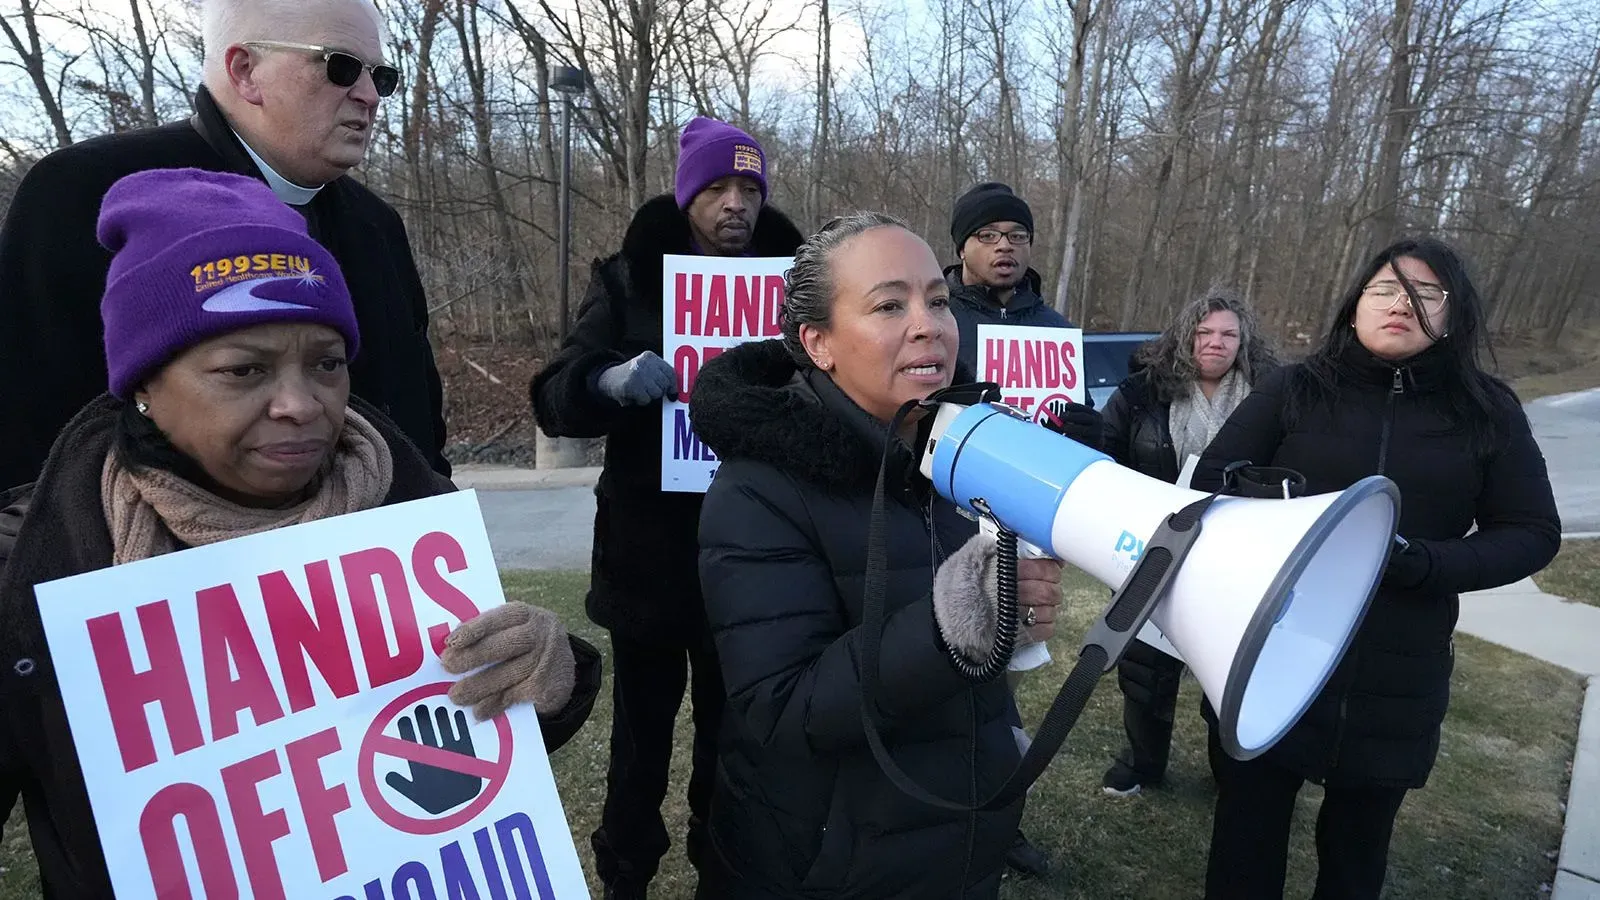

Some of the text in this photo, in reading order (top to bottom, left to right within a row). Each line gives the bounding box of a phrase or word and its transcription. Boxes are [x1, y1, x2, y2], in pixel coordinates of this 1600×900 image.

[190, 253, 311, 285] 1199SEIU
[674, 272, 785, 337] HAND
[985, 338, 1077, 390] HANDS
[86, 531, 481, 774] HANDS
[138, 727, 352, 900] OFF
